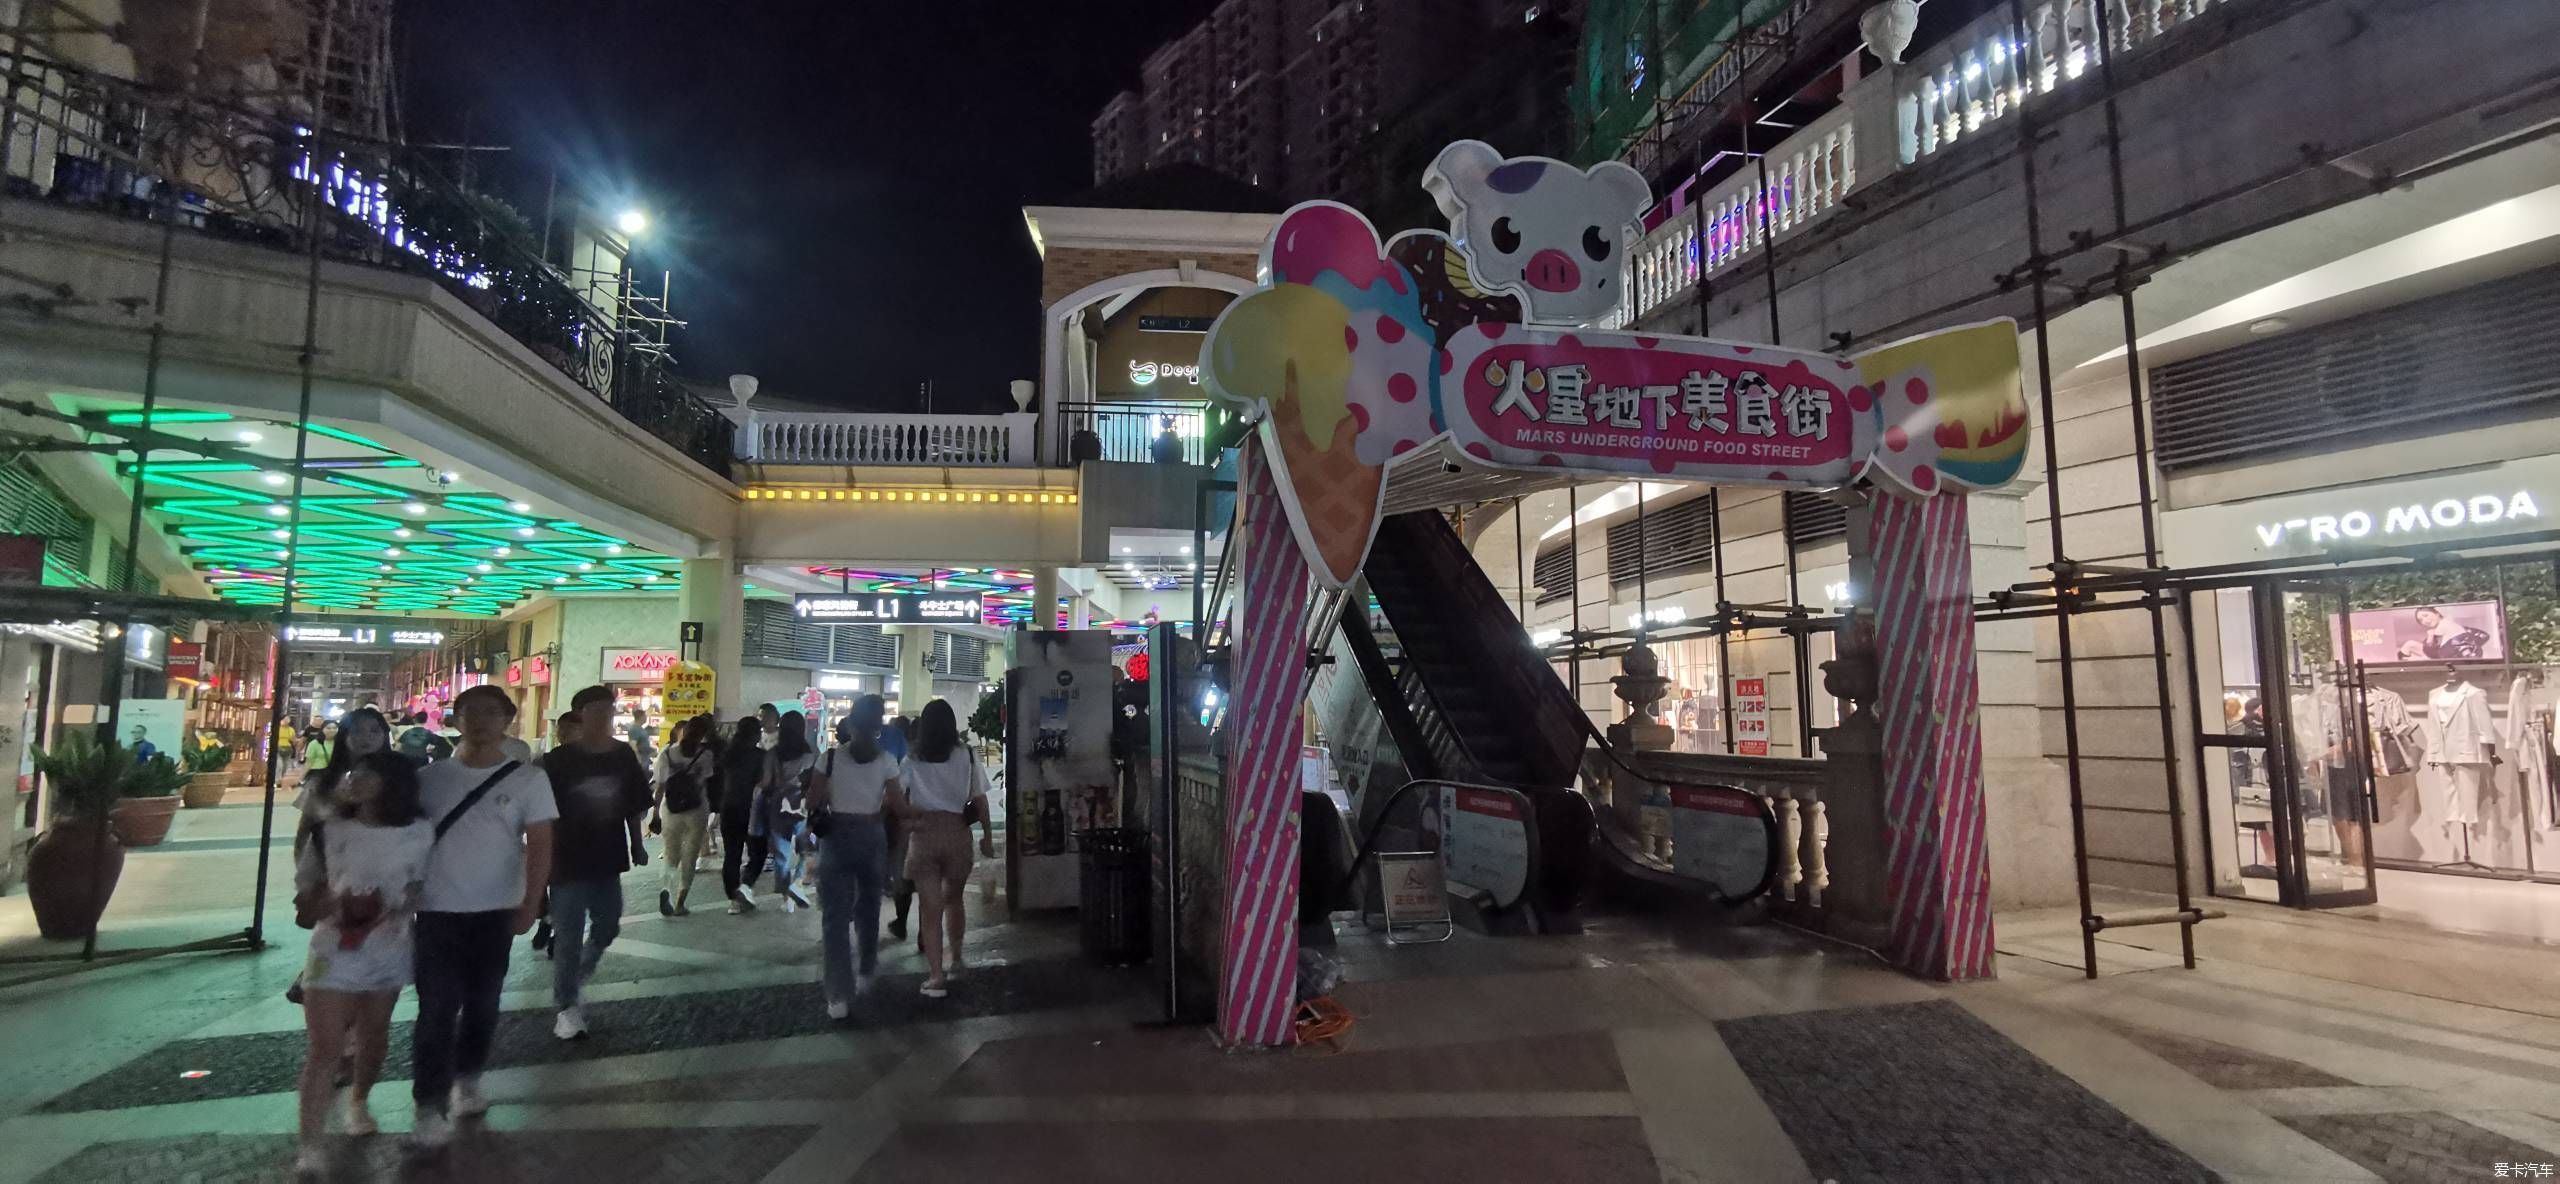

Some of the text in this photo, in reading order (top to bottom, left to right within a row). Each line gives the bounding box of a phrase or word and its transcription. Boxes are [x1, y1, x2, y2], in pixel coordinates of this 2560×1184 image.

[1485, 359, 1832, 441] 火星地下美食街
[1516, 428, 1812, 459] MARS UNDERGROUND FOOD STREET
[2385, 491, 2539, 534] MODA
[877, 599, 899, 618] L1
